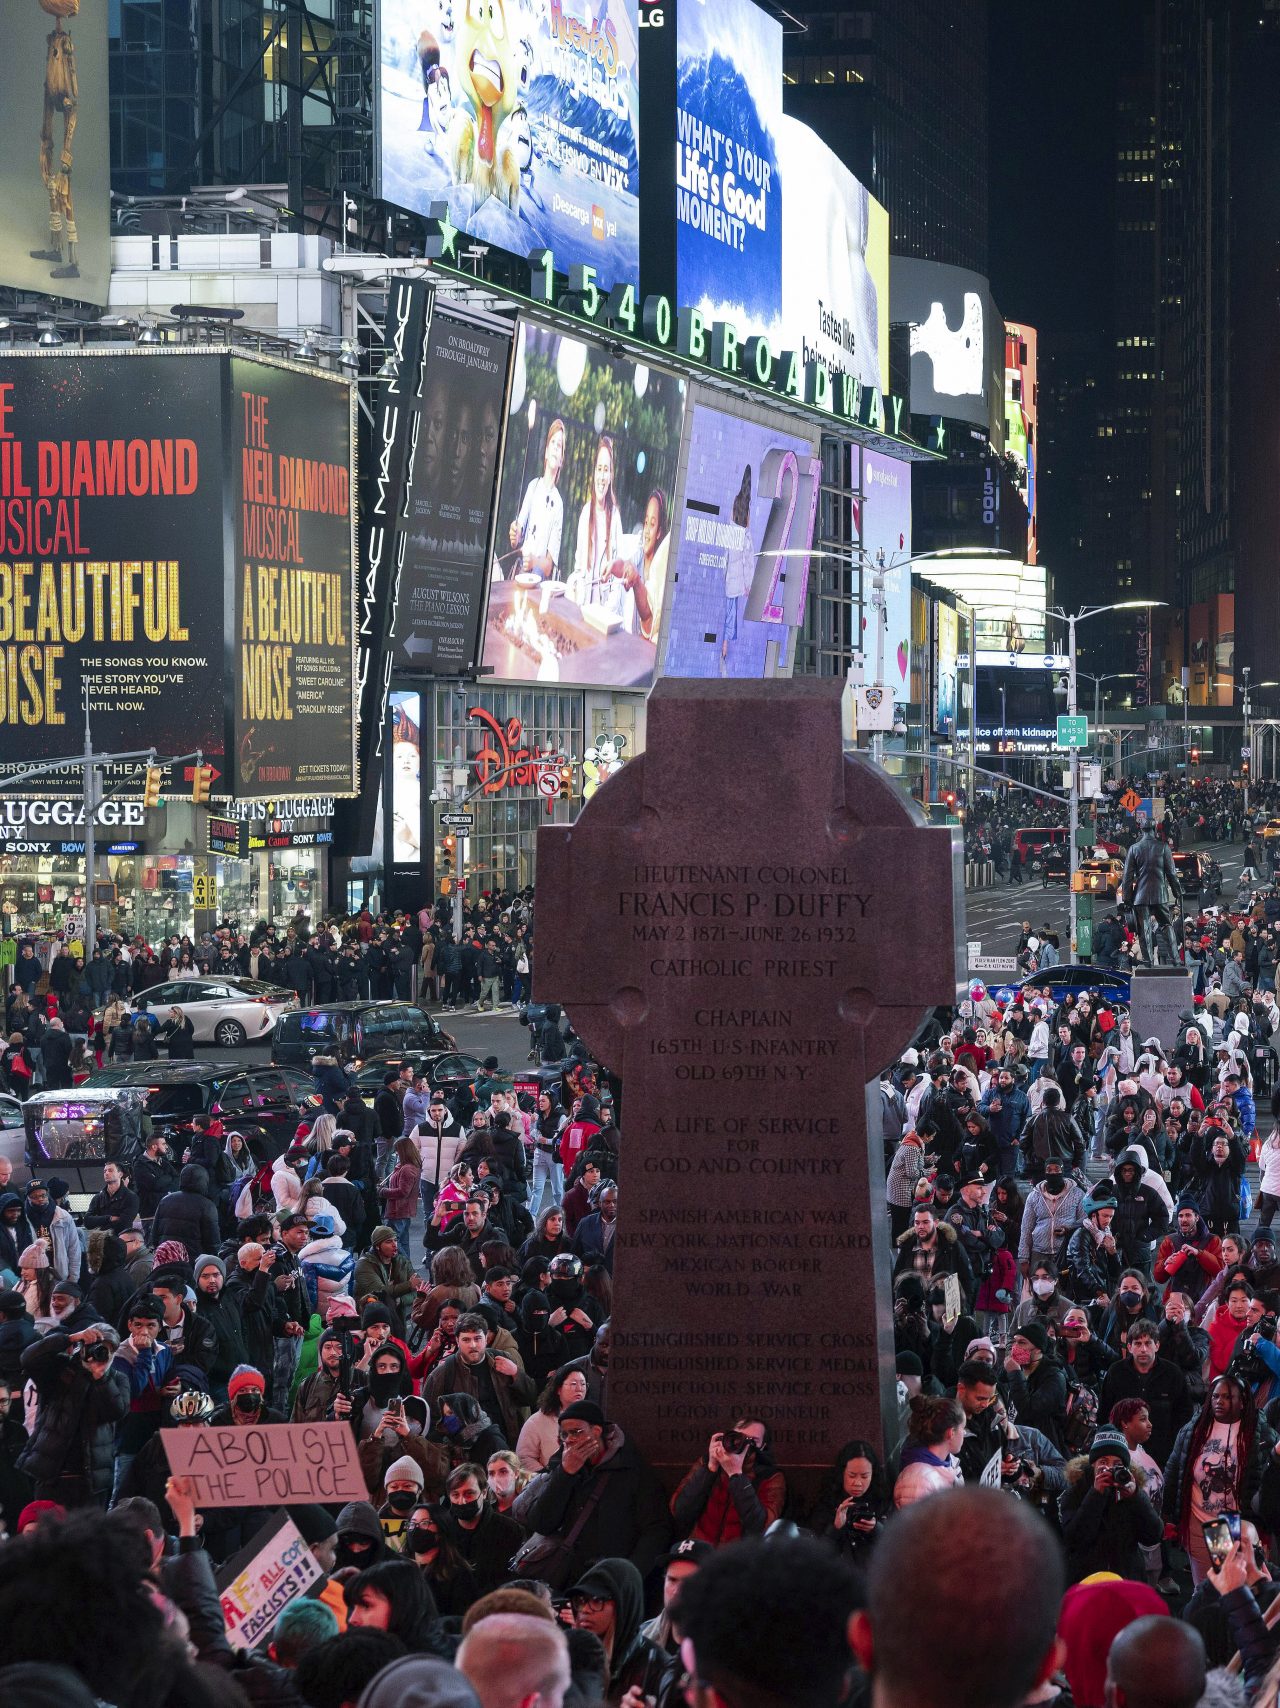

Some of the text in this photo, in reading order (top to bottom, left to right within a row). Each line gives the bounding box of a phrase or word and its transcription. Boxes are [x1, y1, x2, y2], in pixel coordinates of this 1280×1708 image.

[638, 10, 664, 28] LG
[678, 108, 733, 167] WHAT'S
[735, 146, 771, 193] YOUR
[676, 142, 766, 232] Life's Good
[606, 218, 617, 238] ya!
[676, 188, 746, 253] MOMENT?
[818, 300, 842, 343] Tastes
[448, 336, 490, 358] ON BROADWAY
[540, 250, 902, 434] 1540 BROADWAY
[436, 346, 464, 366] THROUGH
[242, 392, 269, 449] THE
[38, 439, 198, 497] DIAMOND
[243, 448, 277, 502] NEIL
[279, 454, 348, 516] DIAMOND
[983, 468, 994, 524] 1500
[243, 504, 304, 562] MUSICAL
[412, 588, 470, 604] AUGUST WILSON'S
[243, 565, 346, 646] A BEAUTIFUL
[425, 601, 470, 616] PIANO LESSON
[80, 658, 208, 667] THE SONGS YOU KNOW.
[296, 656, 318, 664] FEATURING
[81, 674, 184, 684] THE STORY YOU'VE
[242, 644, 293, 721] NOISE
[81, 686, 162, 697] NEVER HEARD,
[81, 702, 146, 712] UNTIL NOW.
[299, 766, 308, 774] GET
[0, 801, 144, 826] UGGAGE
[276, 798, 334, 818] LUGGAGE
[268, 836, 290, 847] Canon
[293, 834, 314, 844] SONY
[316, 833, 332, 842] BOWER
[6, 842, 50, 852] SONY
[111, 844, 135, 852] SAMSUNG
[634, 867, 853, 884] LIEUTENANT COLONEL
[196, 878, 206, 906] ATM
[618, 893, 873, 917] FRANCIS DUFFY
[633, 926, 856, 943] MAY 26 1932
[650, 959, 838, 977] CATHOLIC PRIEST
[675, 1065, 716, 1081] OLD
[675, 1117, 839, 1135] LIFE OF SERVICE
[728, 1139, 760, 1153] FOR
[644, 1157, 846, 1176] GOD AND COUNTRY
[639, 1209, 849, 1226] SPANISH AMERICAN WAR
[617, 1233, 871, 1250] NEW NATIONAL GUARD
[664, 1258, 823, 1273] MEXICAN BORDER
[685, 1281, 802, 1297] WORLD WAR
[747, 1333, 812, 1348] SERVICE
[747, 1355, 812, 1372] SERVICE
[188, 1428, 350, 1468] ABOLISH
[180, 1466, 358, 1501] THE POLICE
[260, 1561, 286, 1591] ALL
